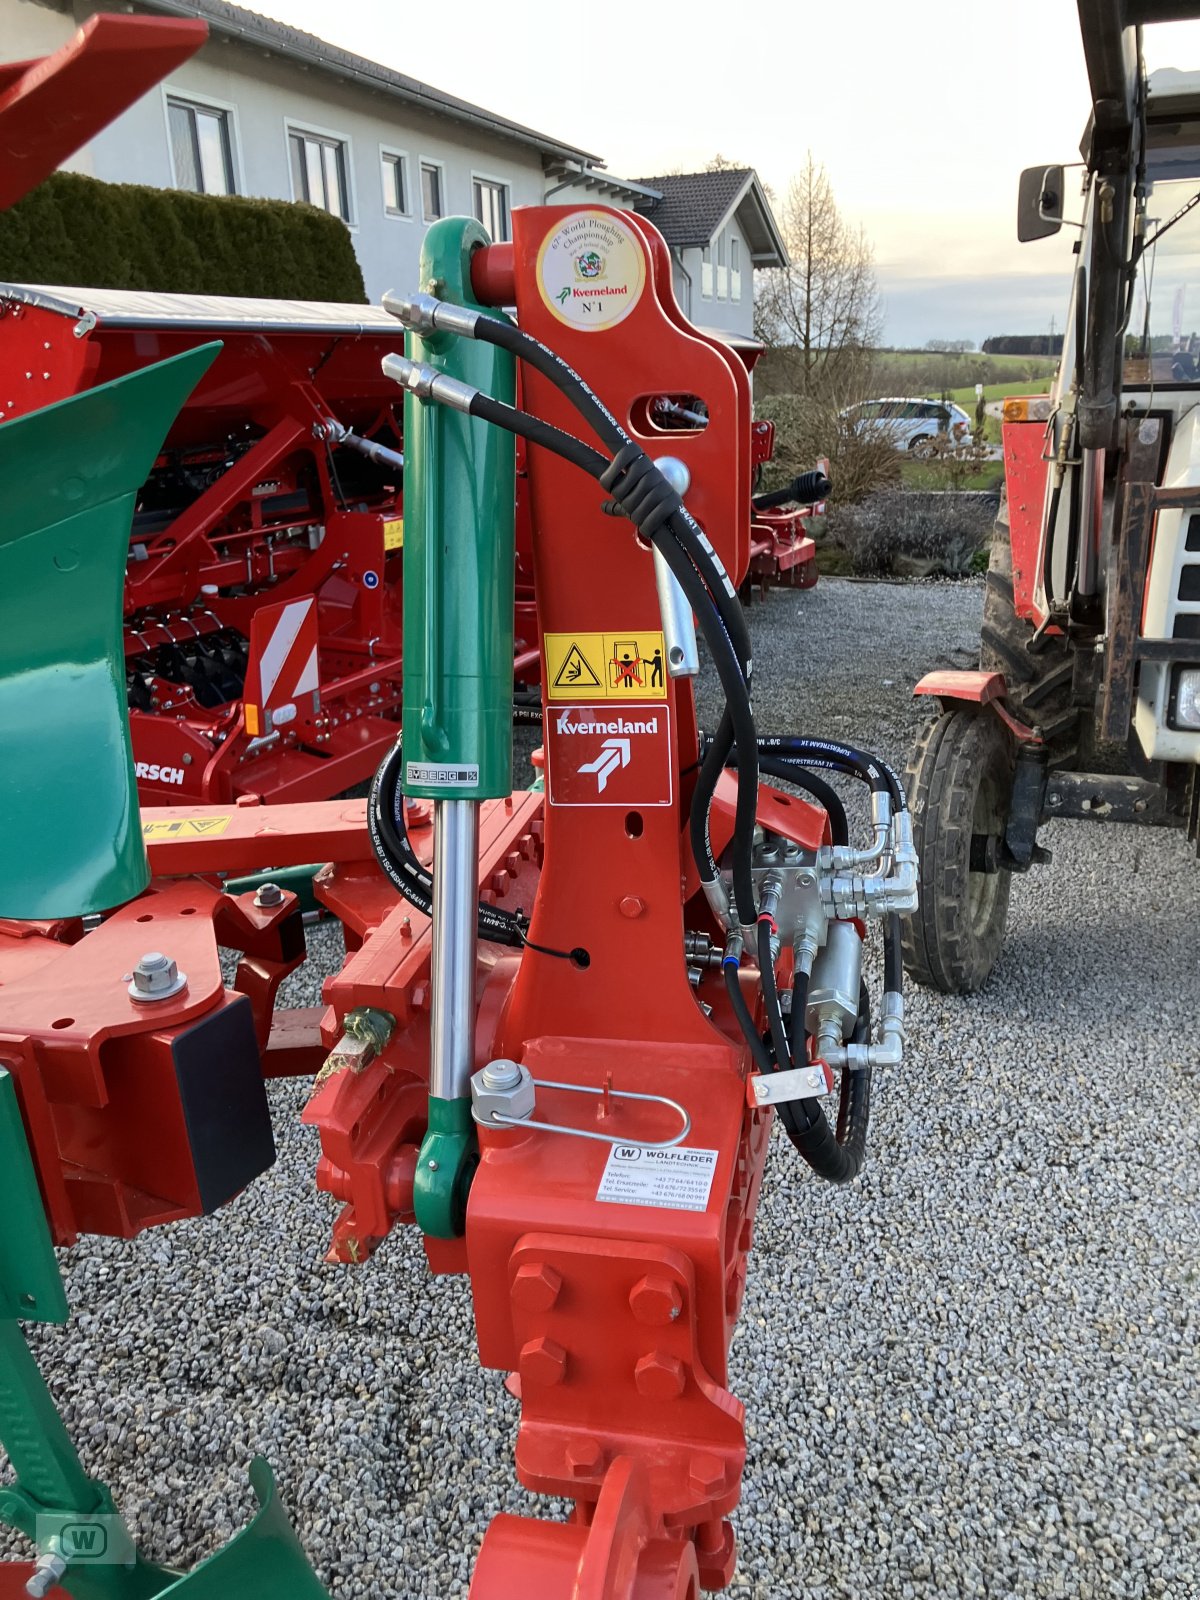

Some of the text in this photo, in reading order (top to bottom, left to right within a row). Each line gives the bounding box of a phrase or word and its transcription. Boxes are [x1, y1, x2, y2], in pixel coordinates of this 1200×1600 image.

[562, 220, 586, 236] World
[589, 219, 625, 244] Ploughing
[563, 230, 614, 249] Championship
[573, 285, 628, 298] Kverneland
[580, 381, 594, 395] Bar
[591, 395, 618, 427] exceeds
[616, 427, 629, 441] EN
[556, 717, 658, 735] Kverneland
[809, 740, 852, 757] SUPERSTREAM
[134, 761, 184, 785] RSCH
[370, 793, 378, 806] Bar
[369, 806, 378, 834] exceeds
[373, 835, 382, 846] EN
[382, 858, 393, 872] 1SC
[389, 871, 406, 891] MSHA
[646, 1150, 713, 1164] WÖLFLEDER
[655, 1160, 699, 1168] LANDTECHNIK
